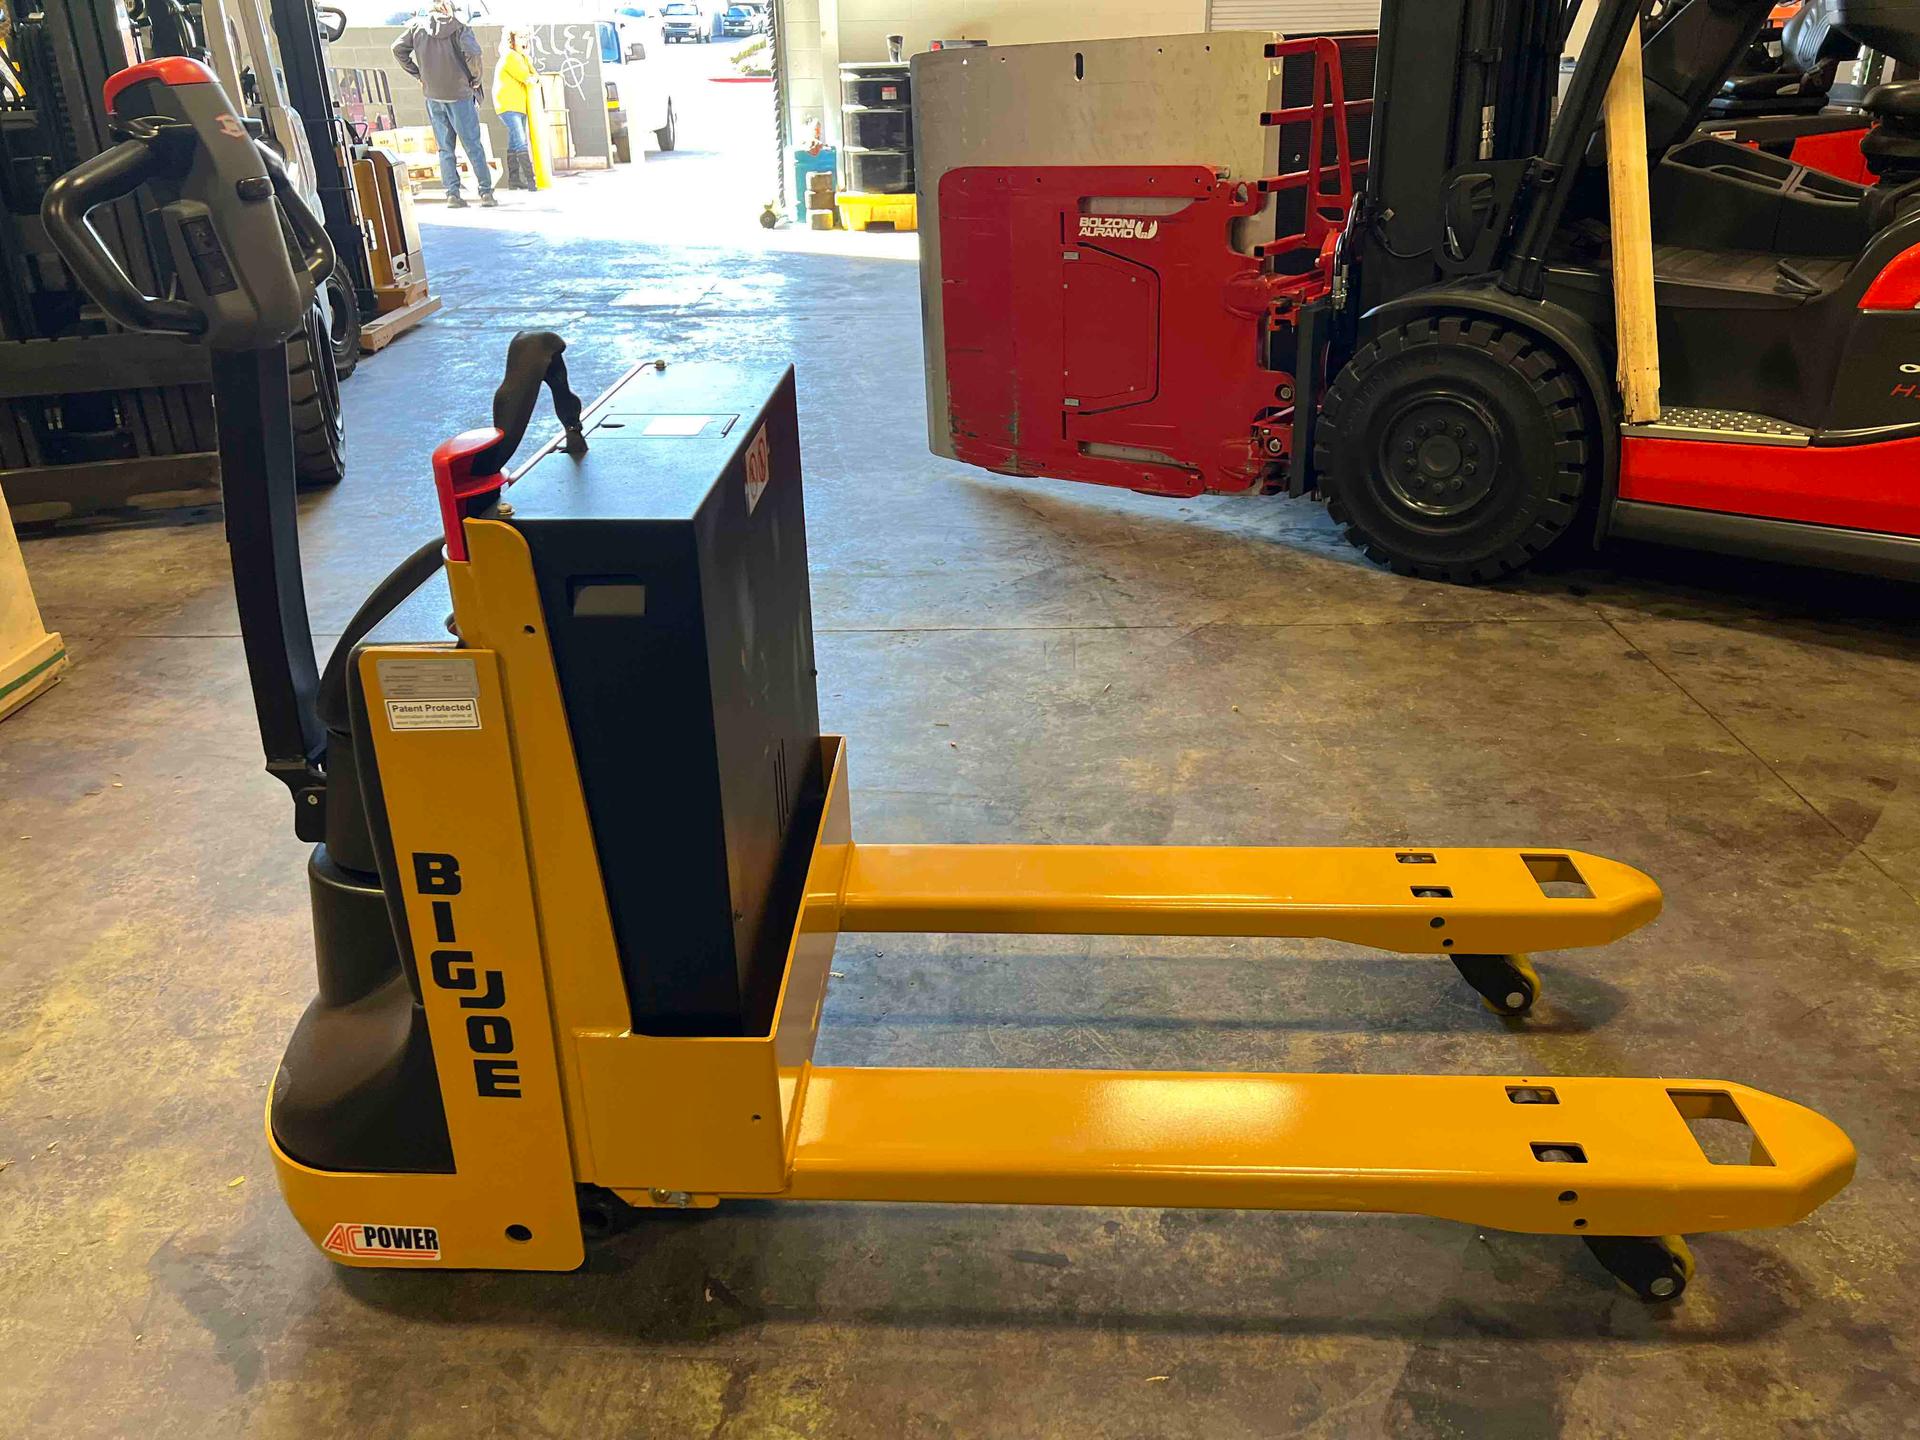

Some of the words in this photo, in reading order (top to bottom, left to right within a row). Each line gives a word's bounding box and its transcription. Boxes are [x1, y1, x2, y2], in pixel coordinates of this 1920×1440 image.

[1079, 217, 1135, 228] BOLZONI
[1078, 228, 1134, 238] AURAMO
[392, 704, 423, 713] Patent
[425, 703, 472, 712] Protected
[363, 1226, 439, 1250] POWER
